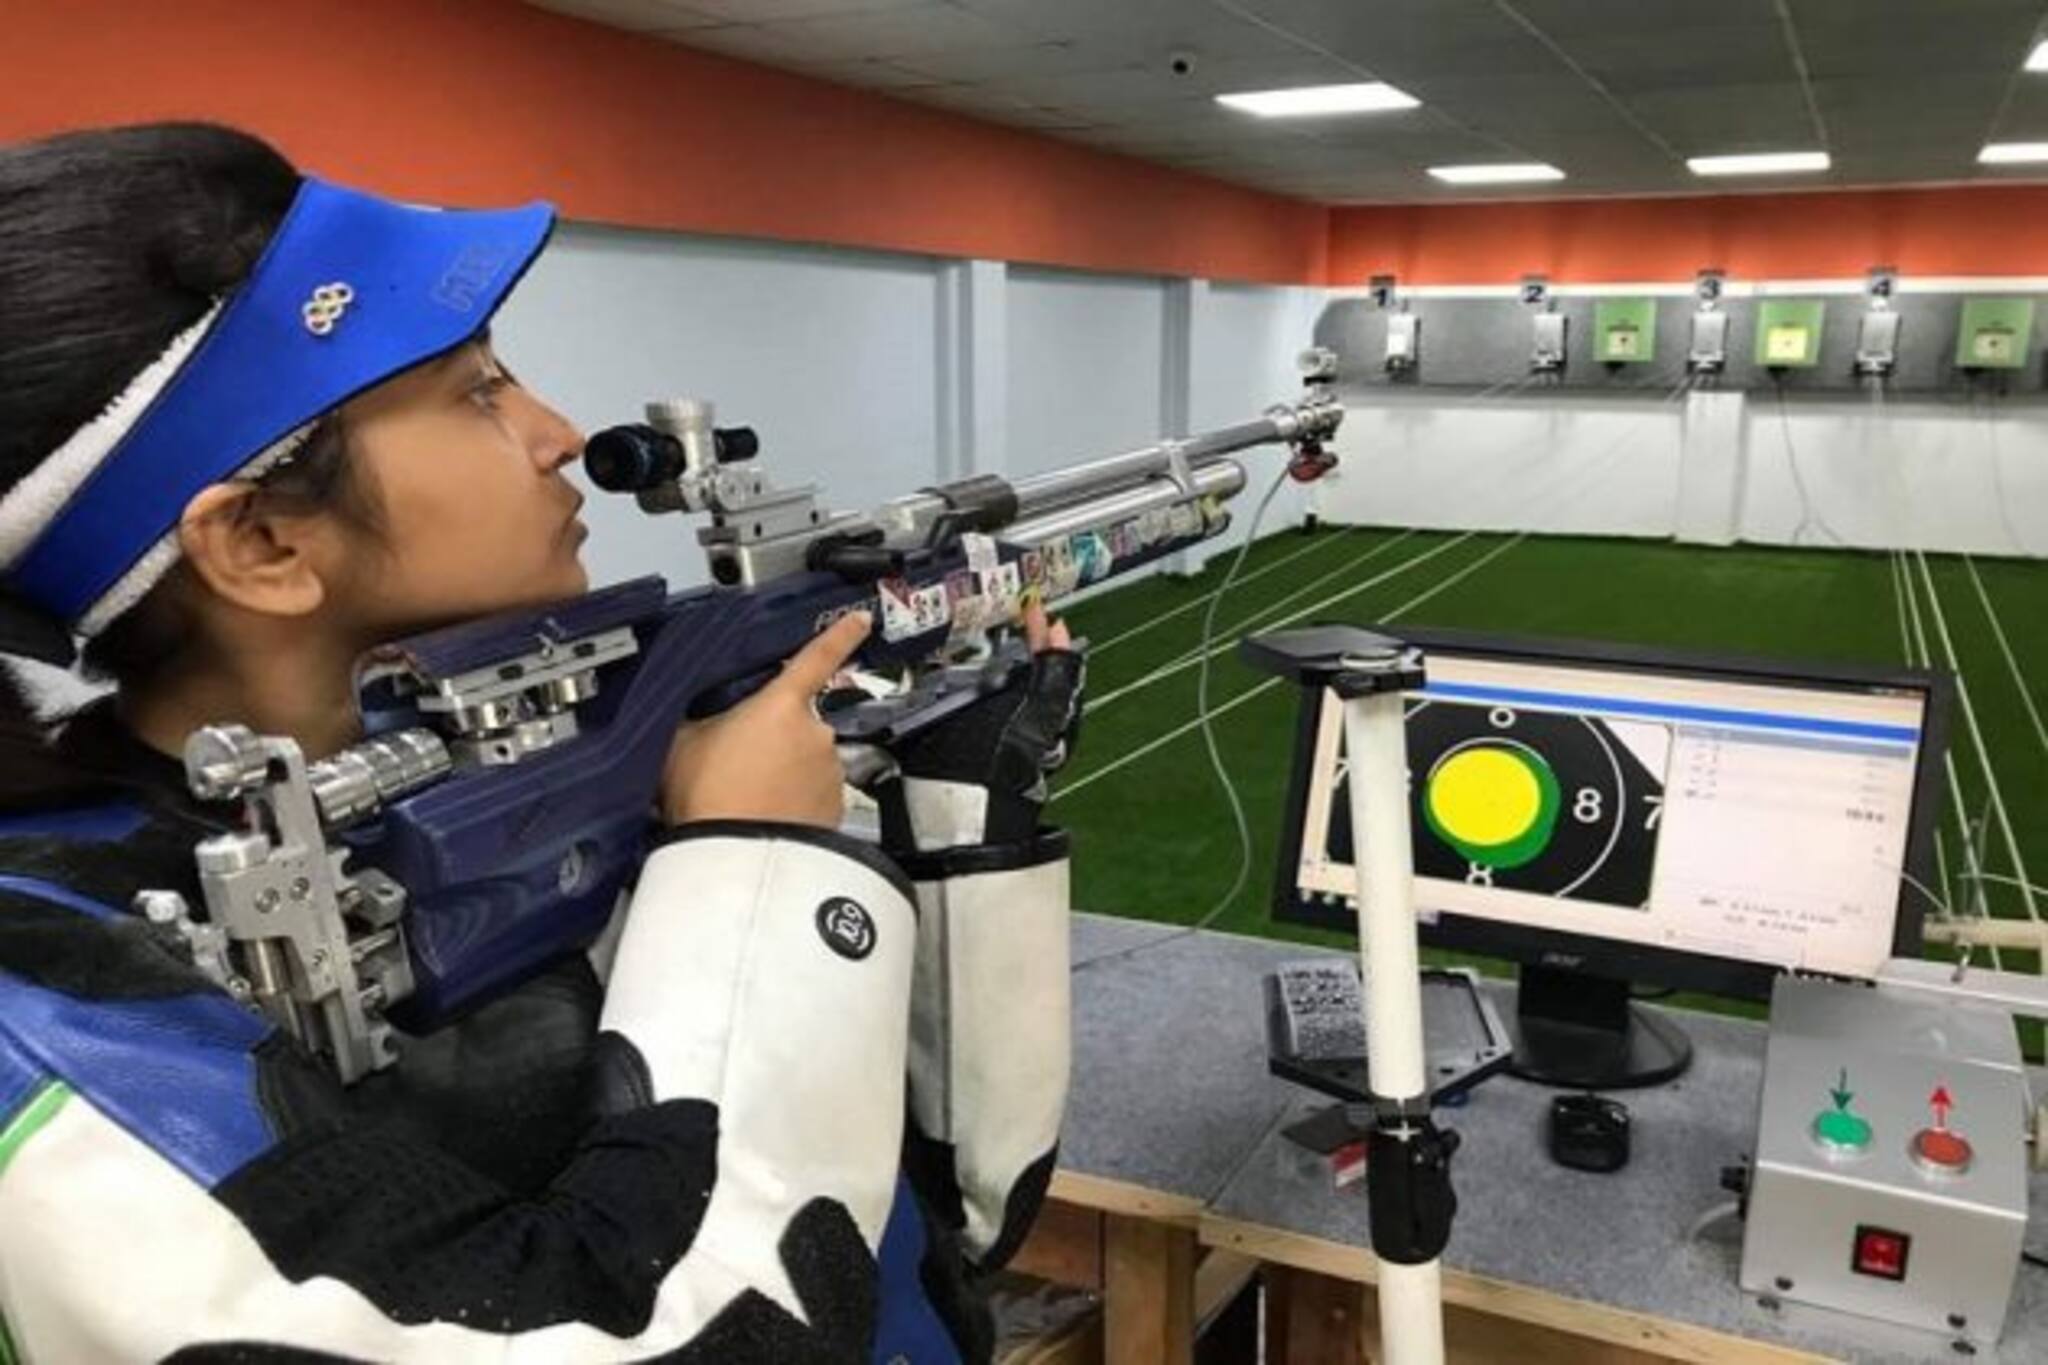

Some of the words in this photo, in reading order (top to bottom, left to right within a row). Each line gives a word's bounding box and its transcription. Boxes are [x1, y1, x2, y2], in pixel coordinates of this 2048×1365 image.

[1523, 284, 1544, 304] 2
[1700, 279, 1720, 300] 3
[1871, 278, 1891, 298] 4
[1573, 786, 1602, 823] 8
[1643, 795, 1664, 830] 7
